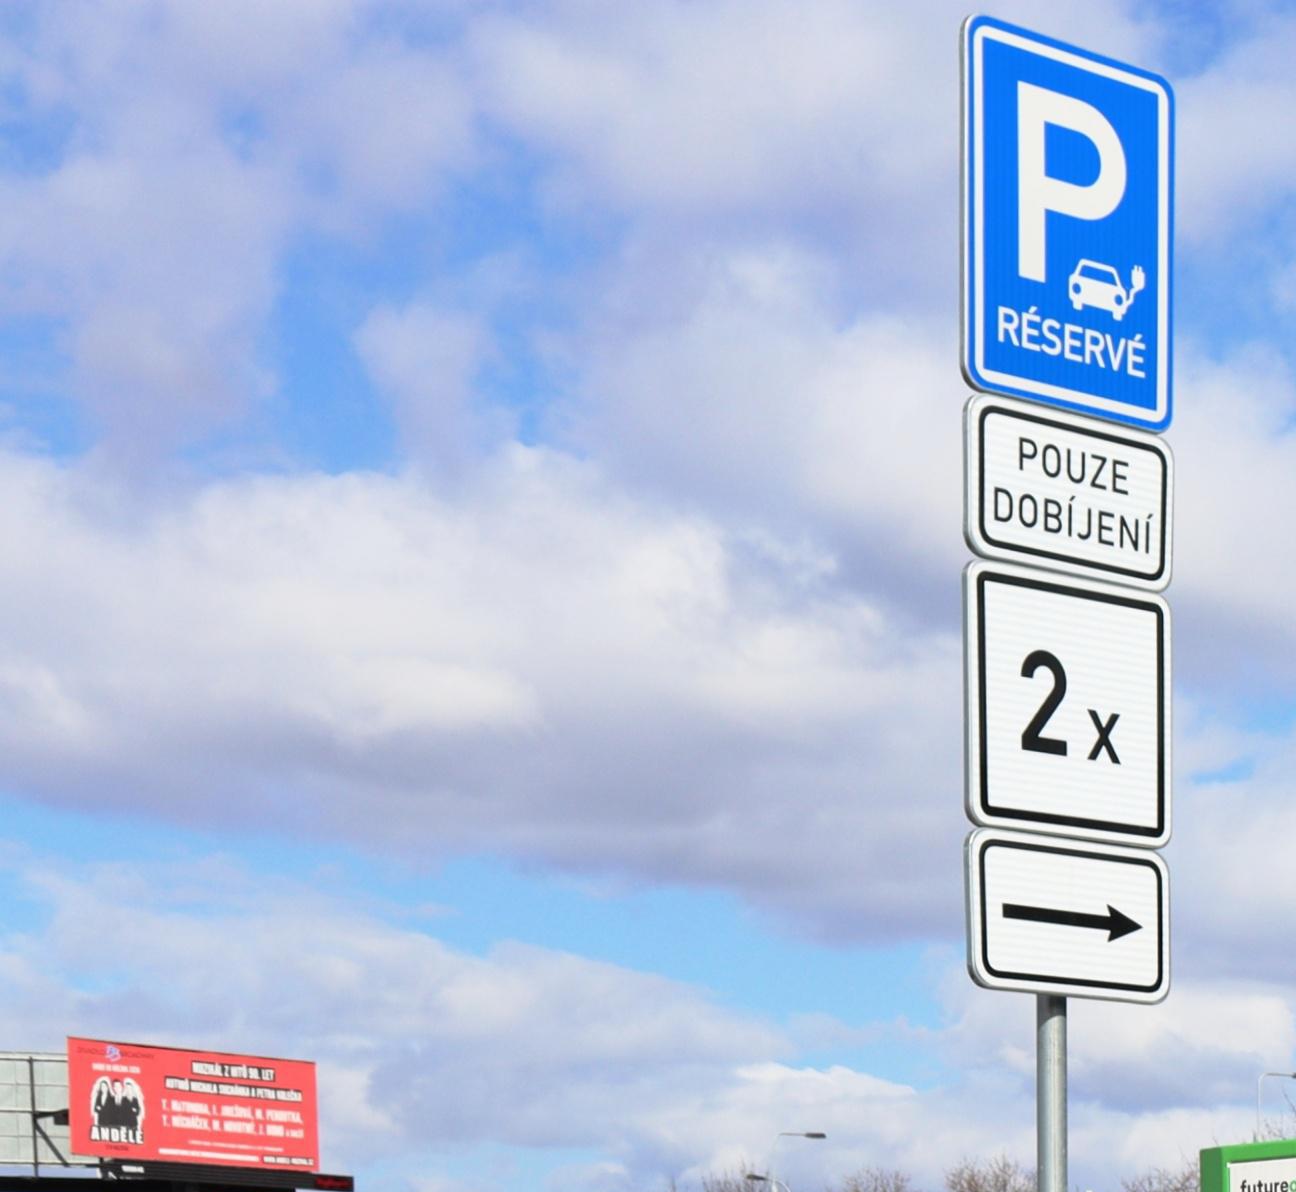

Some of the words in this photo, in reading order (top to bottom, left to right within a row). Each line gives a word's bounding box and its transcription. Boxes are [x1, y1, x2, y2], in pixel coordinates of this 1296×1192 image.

[1017, 80, 1127, 283] P
[997, 305, 1147, 379] RÉSERVÉ
[1018, 436, 1129, 496] POUZE
[993, 486, 1154, 554] DOBÍJENÍ
[1020, 649, 1068, 757] 2
